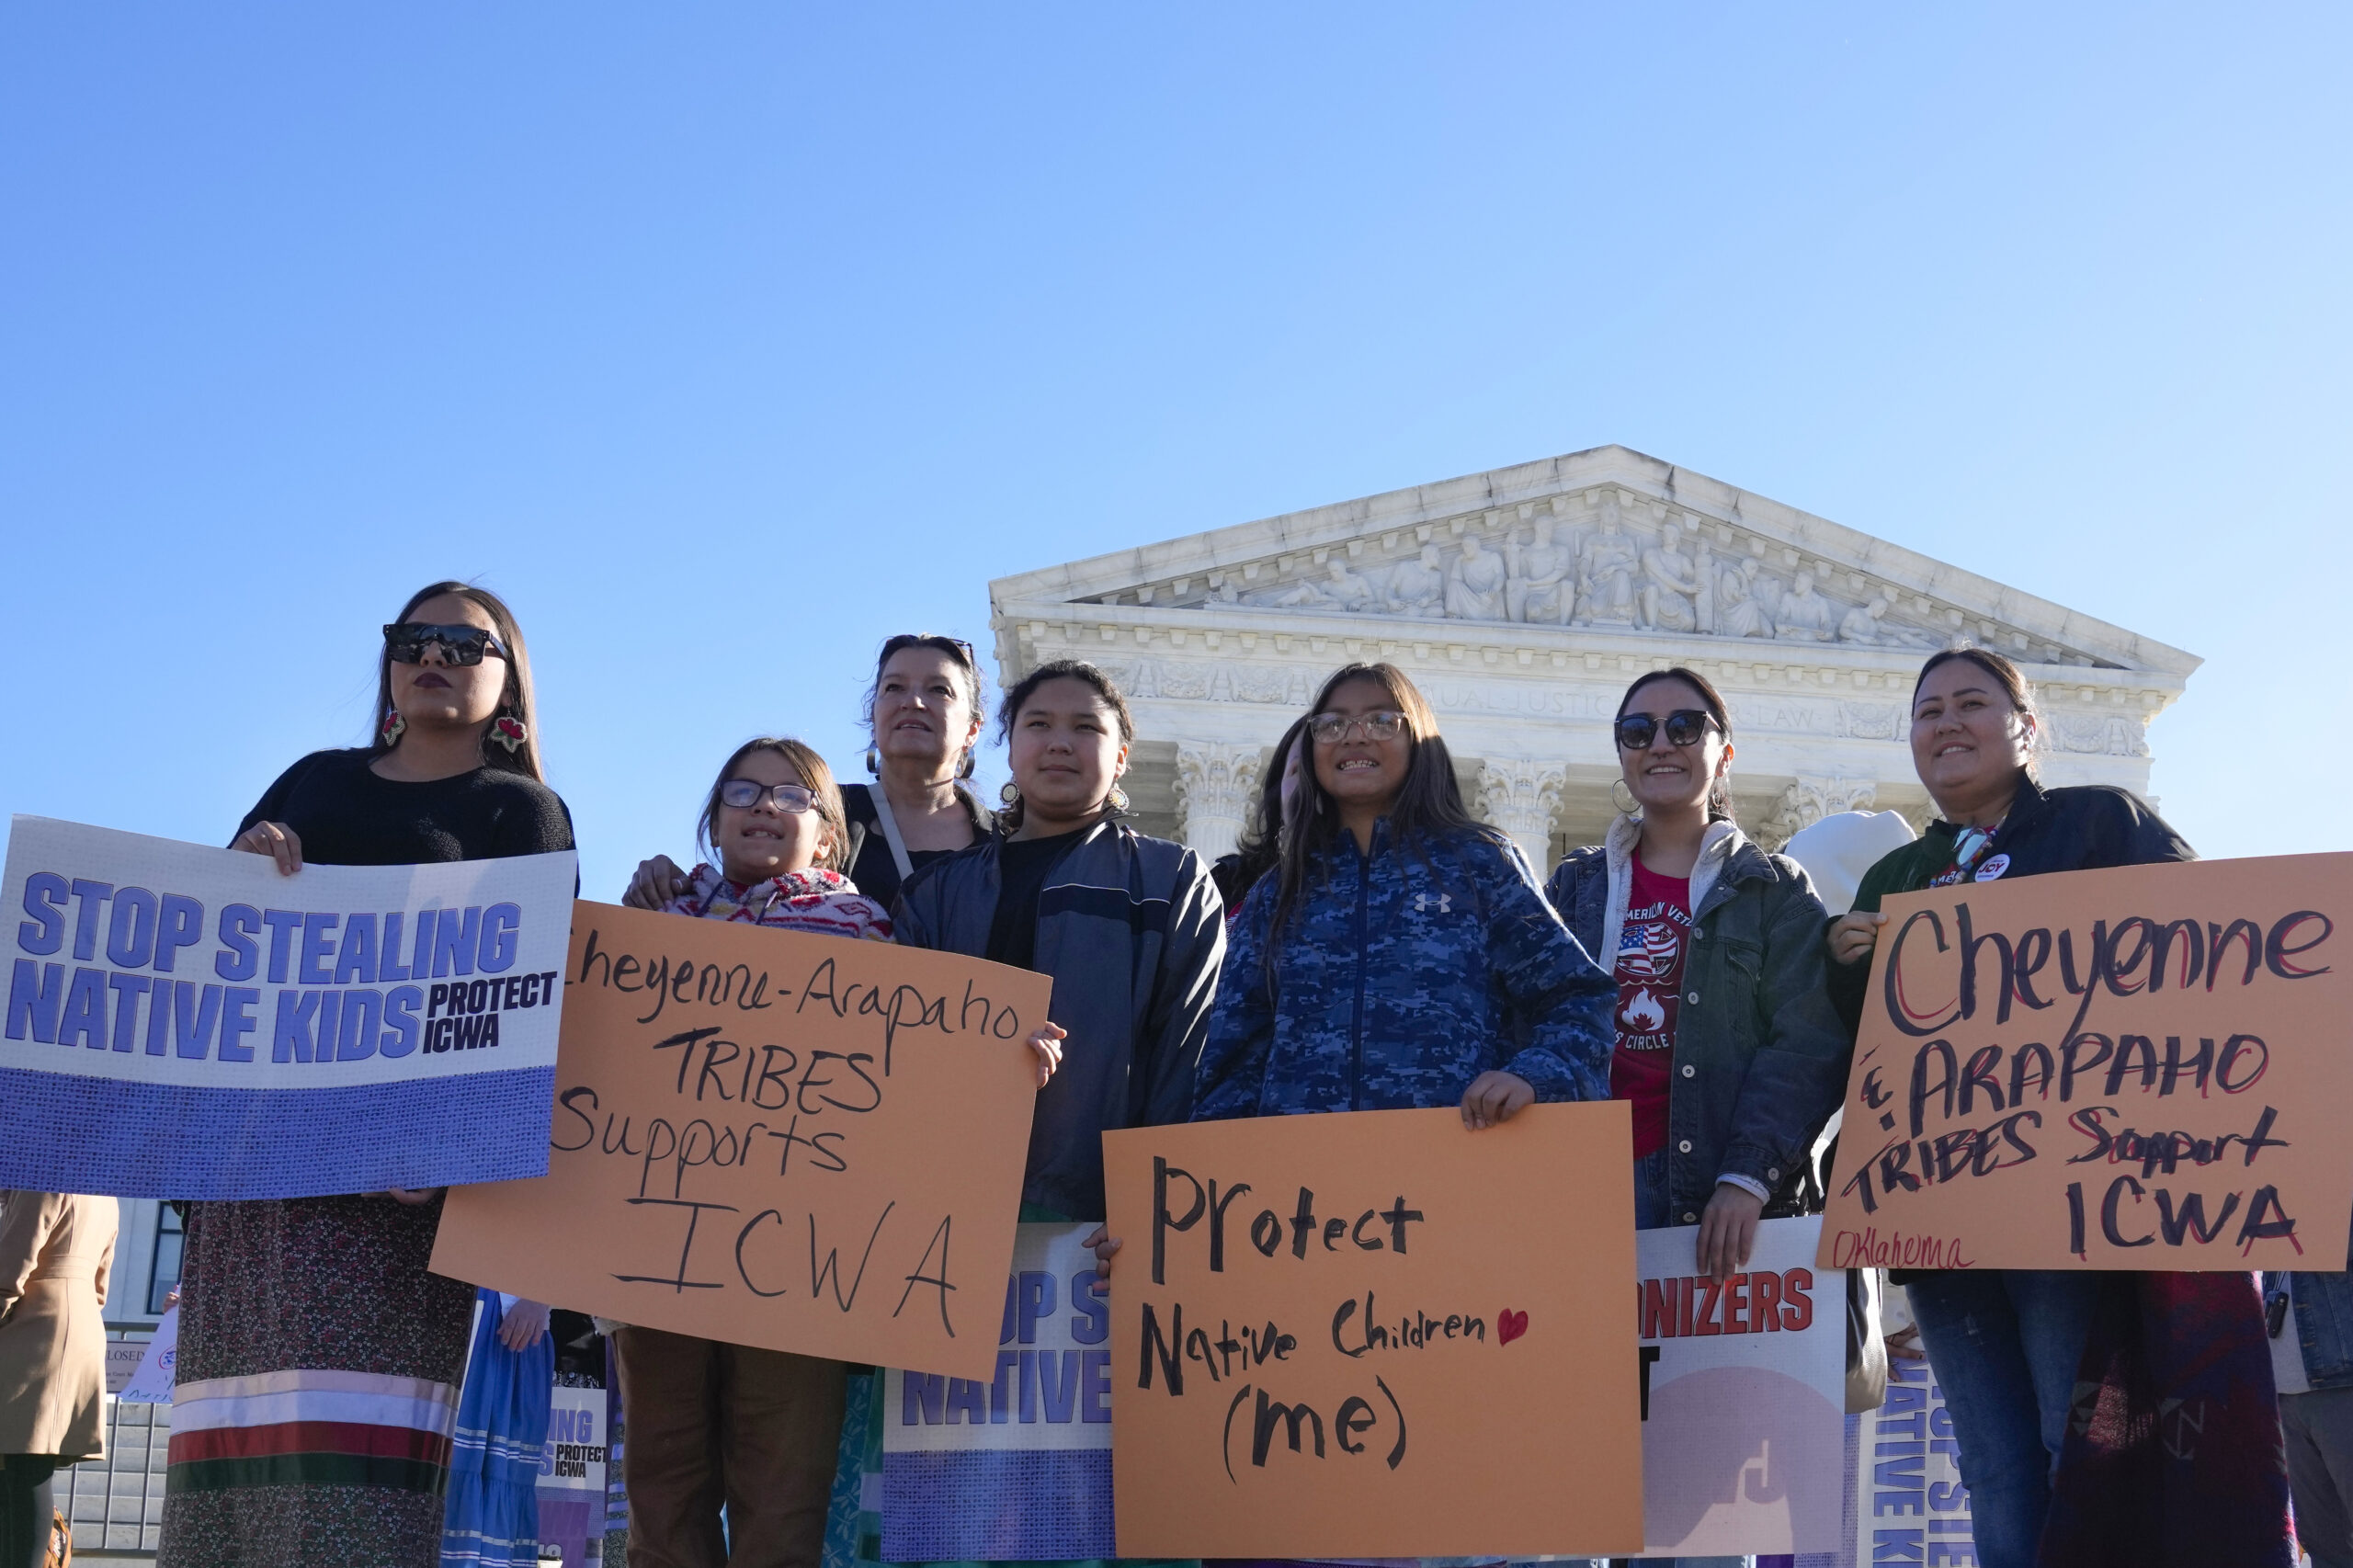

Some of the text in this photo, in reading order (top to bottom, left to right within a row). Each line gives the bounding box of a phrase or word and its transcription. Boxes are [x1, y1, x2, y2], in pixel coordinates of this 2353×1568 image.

[1506, 689, 1620, 717] JUSTIC
[1978, 863, 2005, 873] JOY
[17, 871, 522, 985] STOP STEALING
[1884, 902, 2335, 1051] Cheyenne
[5, 958, 425, 1063] NATIVE KIDS
[422, 1013, 500, 1054] ICWA
[426, 971, 558, 1017] PROTECT
[564, 926, 1019, 1077] heyenne-Arapaho
[1625, 1032, 1670, 1051] CIRCLE
[653, 1026, 882, 1114] TRIBES
[1909, 1032, 2269, 1140] ARAPAHO
[551, 1086, 848, 1199] Supports
[1840, 1109, 2042, 1216] TRIBES
[610, 1197, 958, 1339] ICWA
[1152, 1155, 1425, 1286] Protect
[2065, 1174, 2304, 1263] ICWA
[107, 1349, 145, 1362] LOSED
[1138, 1301, 1298, 1397] Native
[1331, 1290, 1486, 1358] Children
[1637, 1267, 1813, 1339] NIZERS
[554, 1460, 587, 1479] ICWA
[1223, 1374, 1407, 1486] (me)
